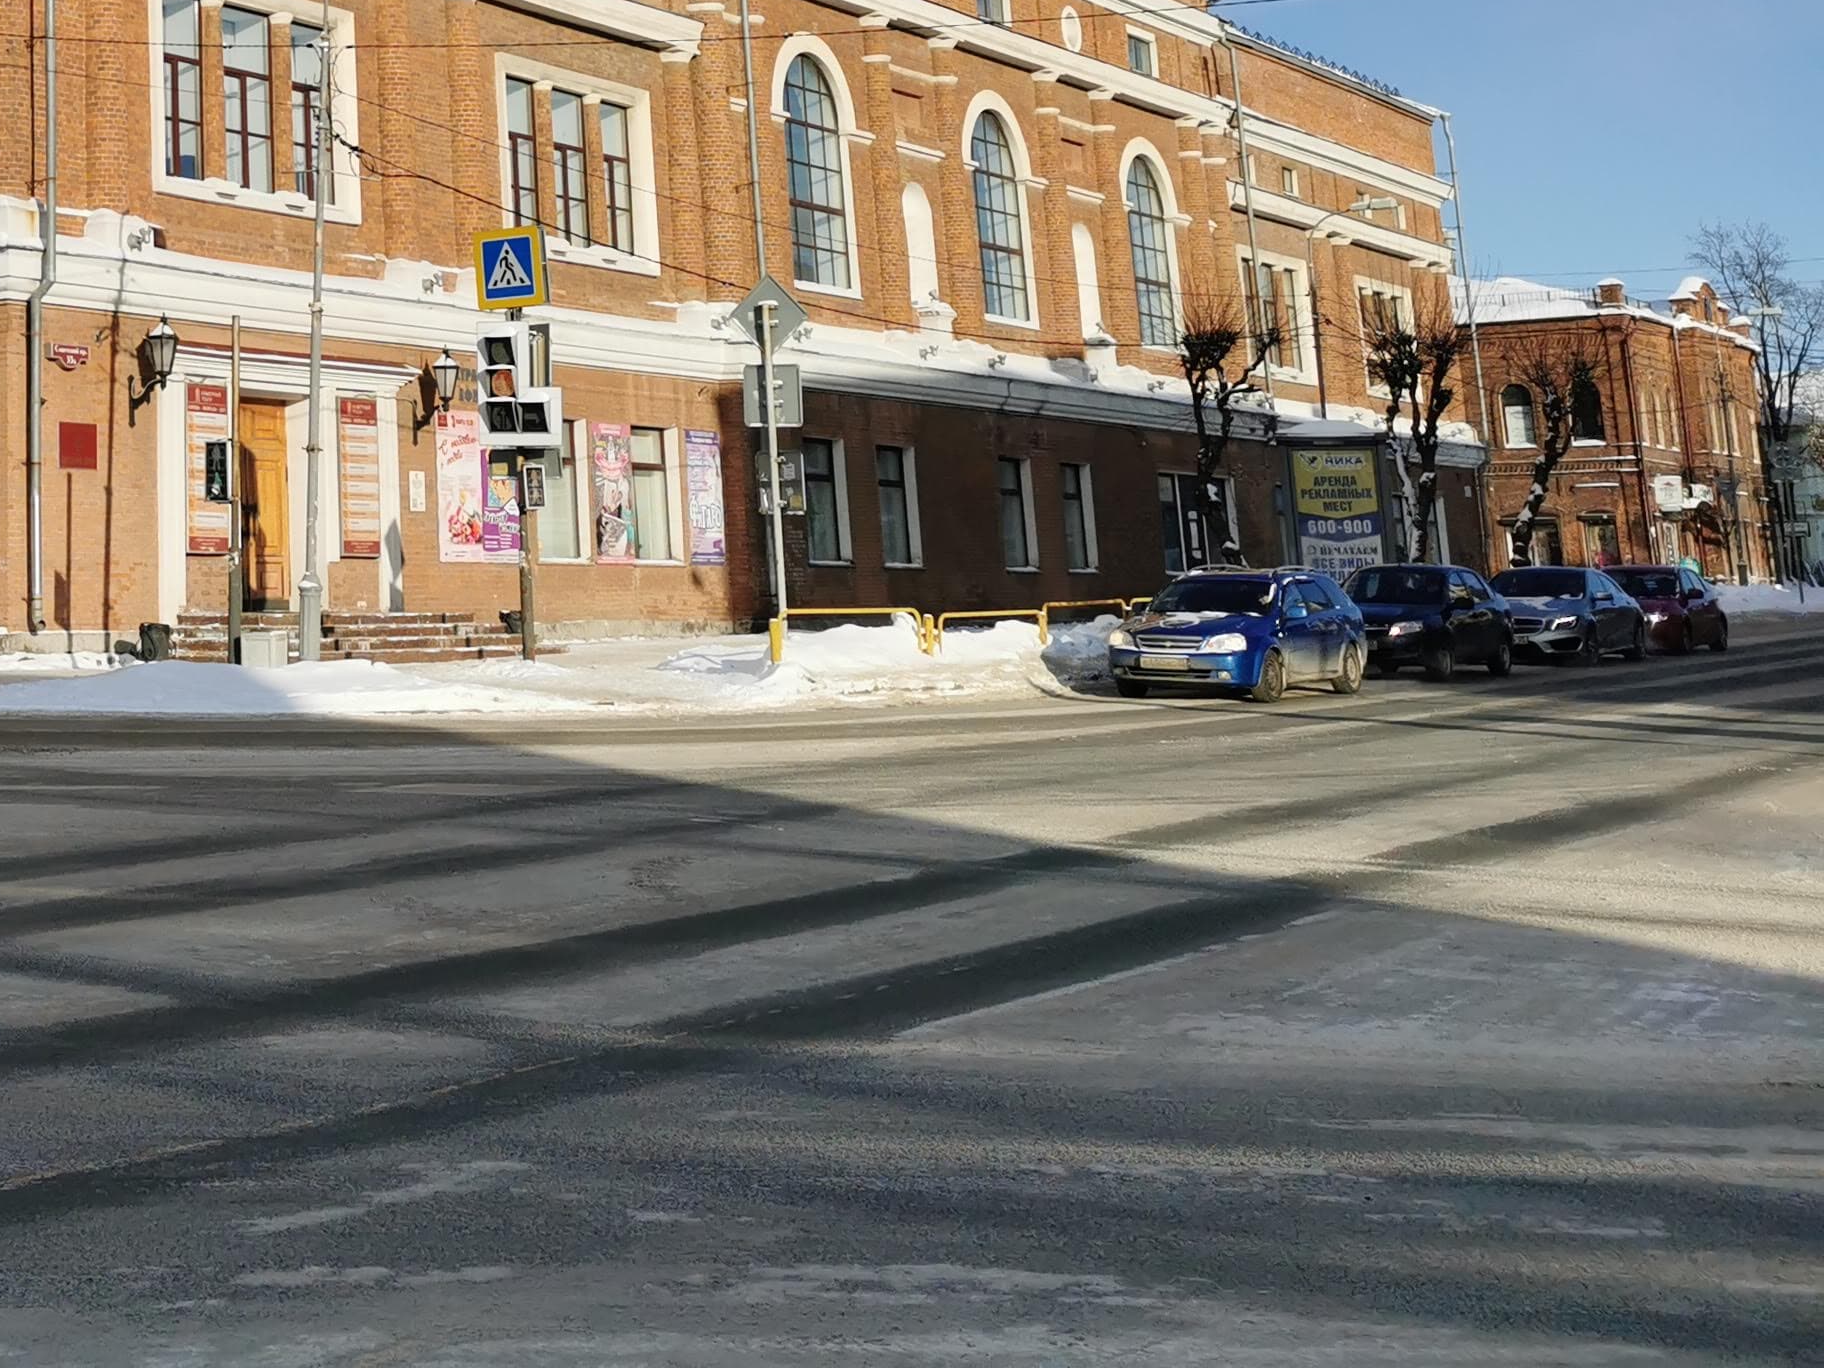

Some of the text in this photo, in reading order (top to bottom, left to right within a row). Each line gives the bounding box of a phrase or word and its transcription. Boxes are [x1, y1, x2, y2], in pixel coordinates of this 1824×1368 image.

[1325, 455, 1363, 466] НИКА
[1313, 475, 1357, 488] АРЕНДА
[1300, 487, 1373, 500] РЕКЛАМНЫХ
[1322, 501, 1353, 512] МЕСТ
[1307, 519, 1373, 534] 600-900
[1320, 544, 1378, 557] ПЕЧАТАЕМ
[1339, 556, 1376, 570] ВИДЫ
